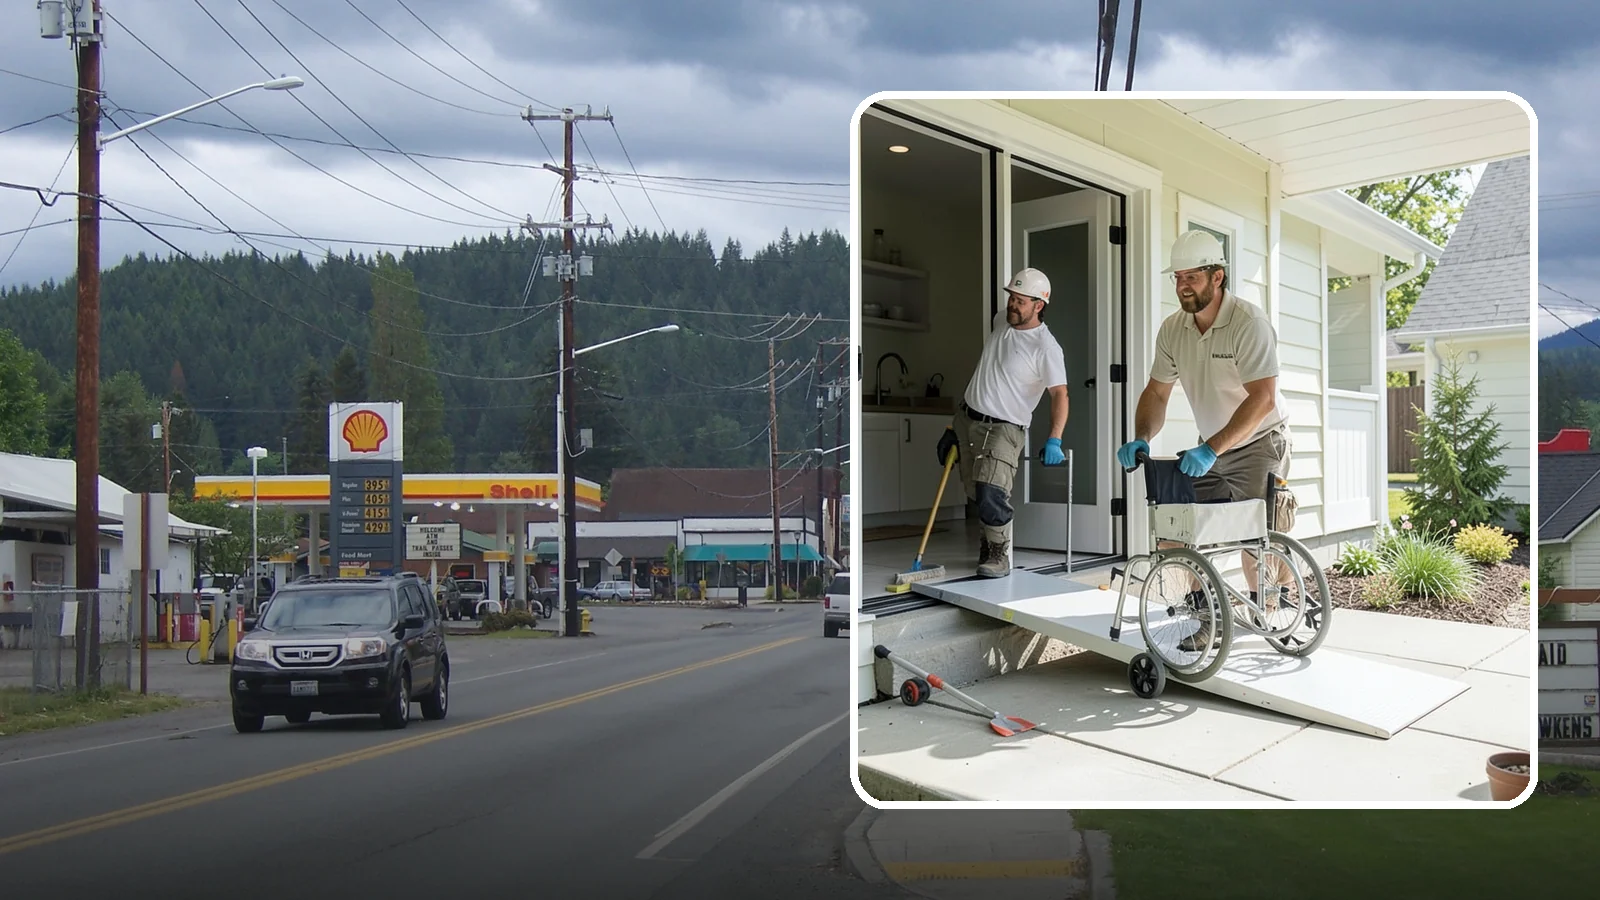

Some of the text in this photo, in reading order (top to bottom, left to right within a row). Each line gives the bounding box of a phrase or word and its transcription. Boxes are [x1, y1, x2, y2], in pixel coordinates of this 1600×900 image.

[366, 480, 384, 490] 395
[490, 484, 547, 498] Shell
[366, 494, 384, 504] 405
[366, 508, 383, 518] 415
[366, 522, 383, 532] 429
